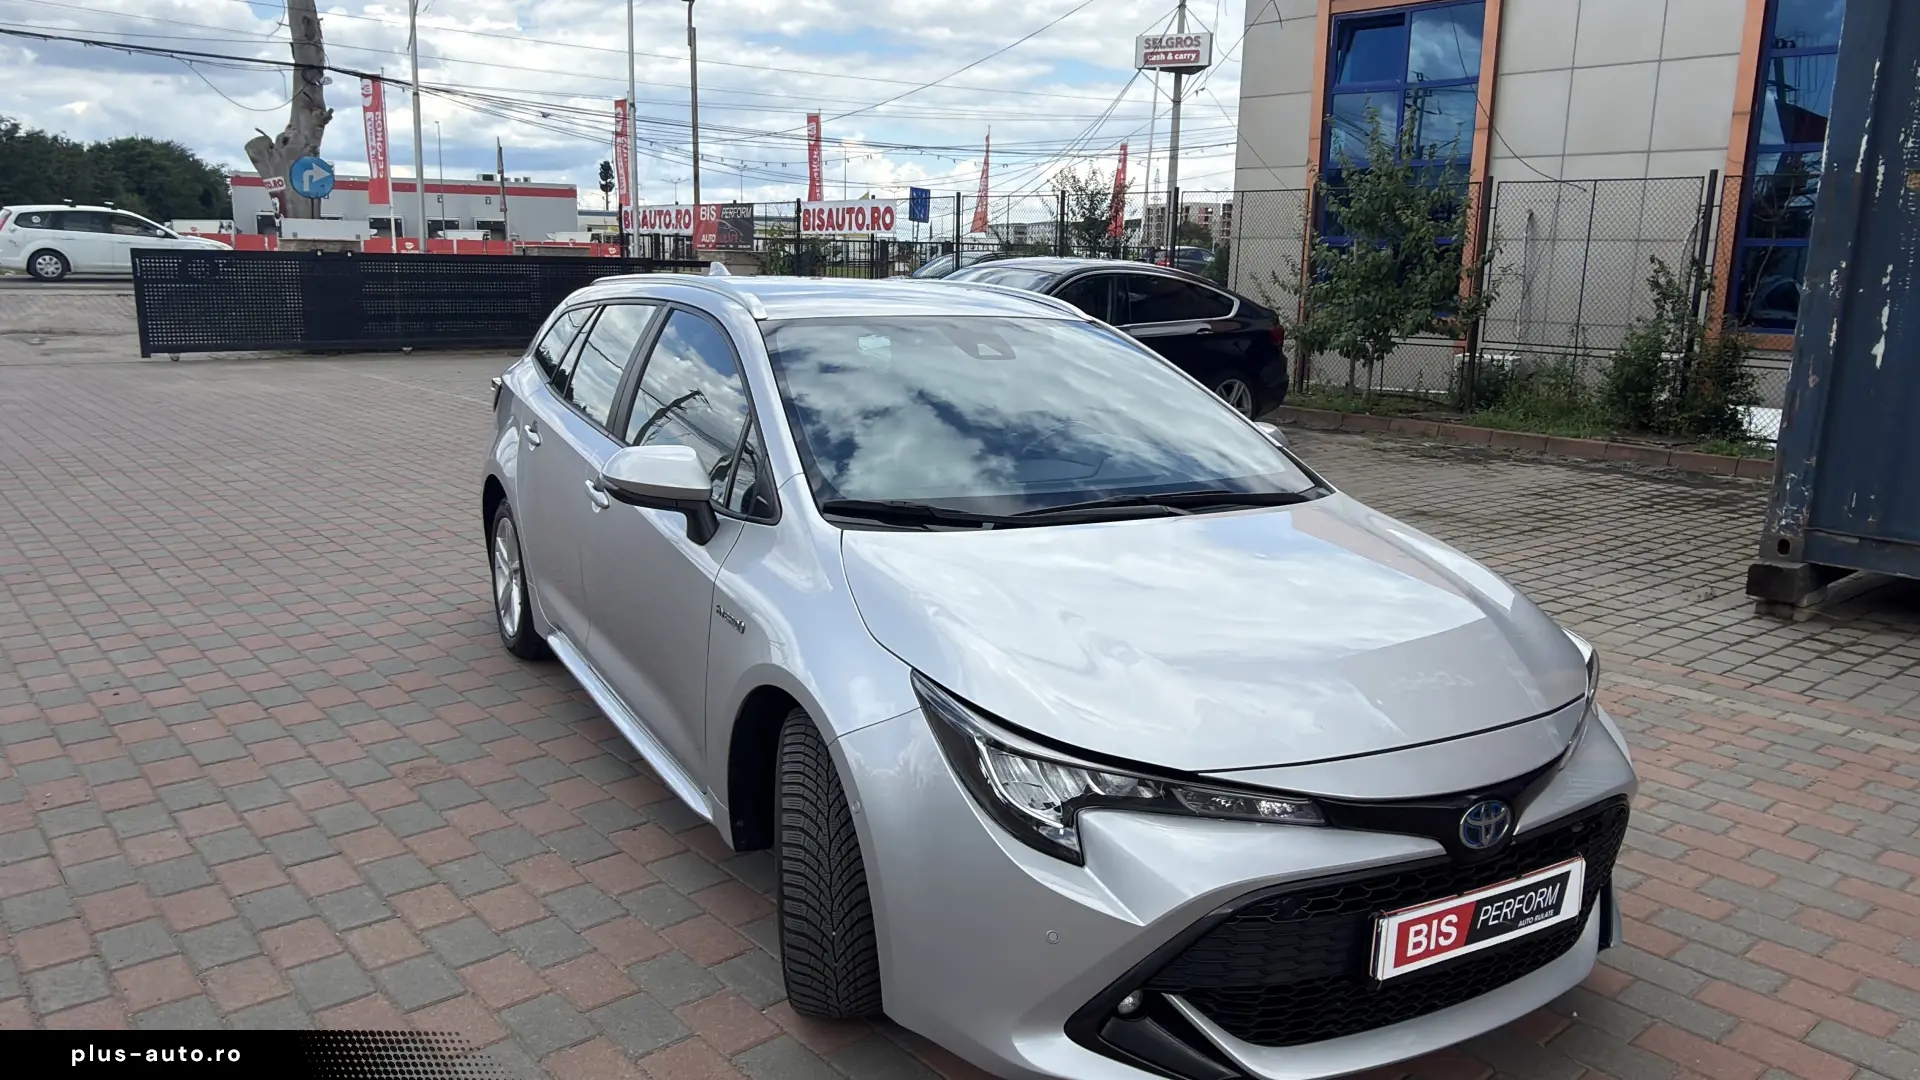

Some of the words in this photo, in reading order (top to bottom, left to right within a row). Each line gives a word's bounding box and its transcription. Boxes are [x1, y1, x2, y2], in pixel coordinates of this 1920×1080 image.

[1144, 36, 1202, 50] SELGROS
[1147, 53, 1165, 61] cash
[1174, 53, 1197, 61] carry
[700, 206, 716, 221] BIS
[720, 207, 752, 219] PERFORM
[802, 206, 895, 231] BISAUTO.RO
[701, 233, 716, 243] AUTO
[1406, 914, 1459, 957] BIS
[1476, 882, 1561, 929] PERFORM
[1518, 916, 1533, 927] AUTO
[1534, 909, 1554, 923] RULATE
